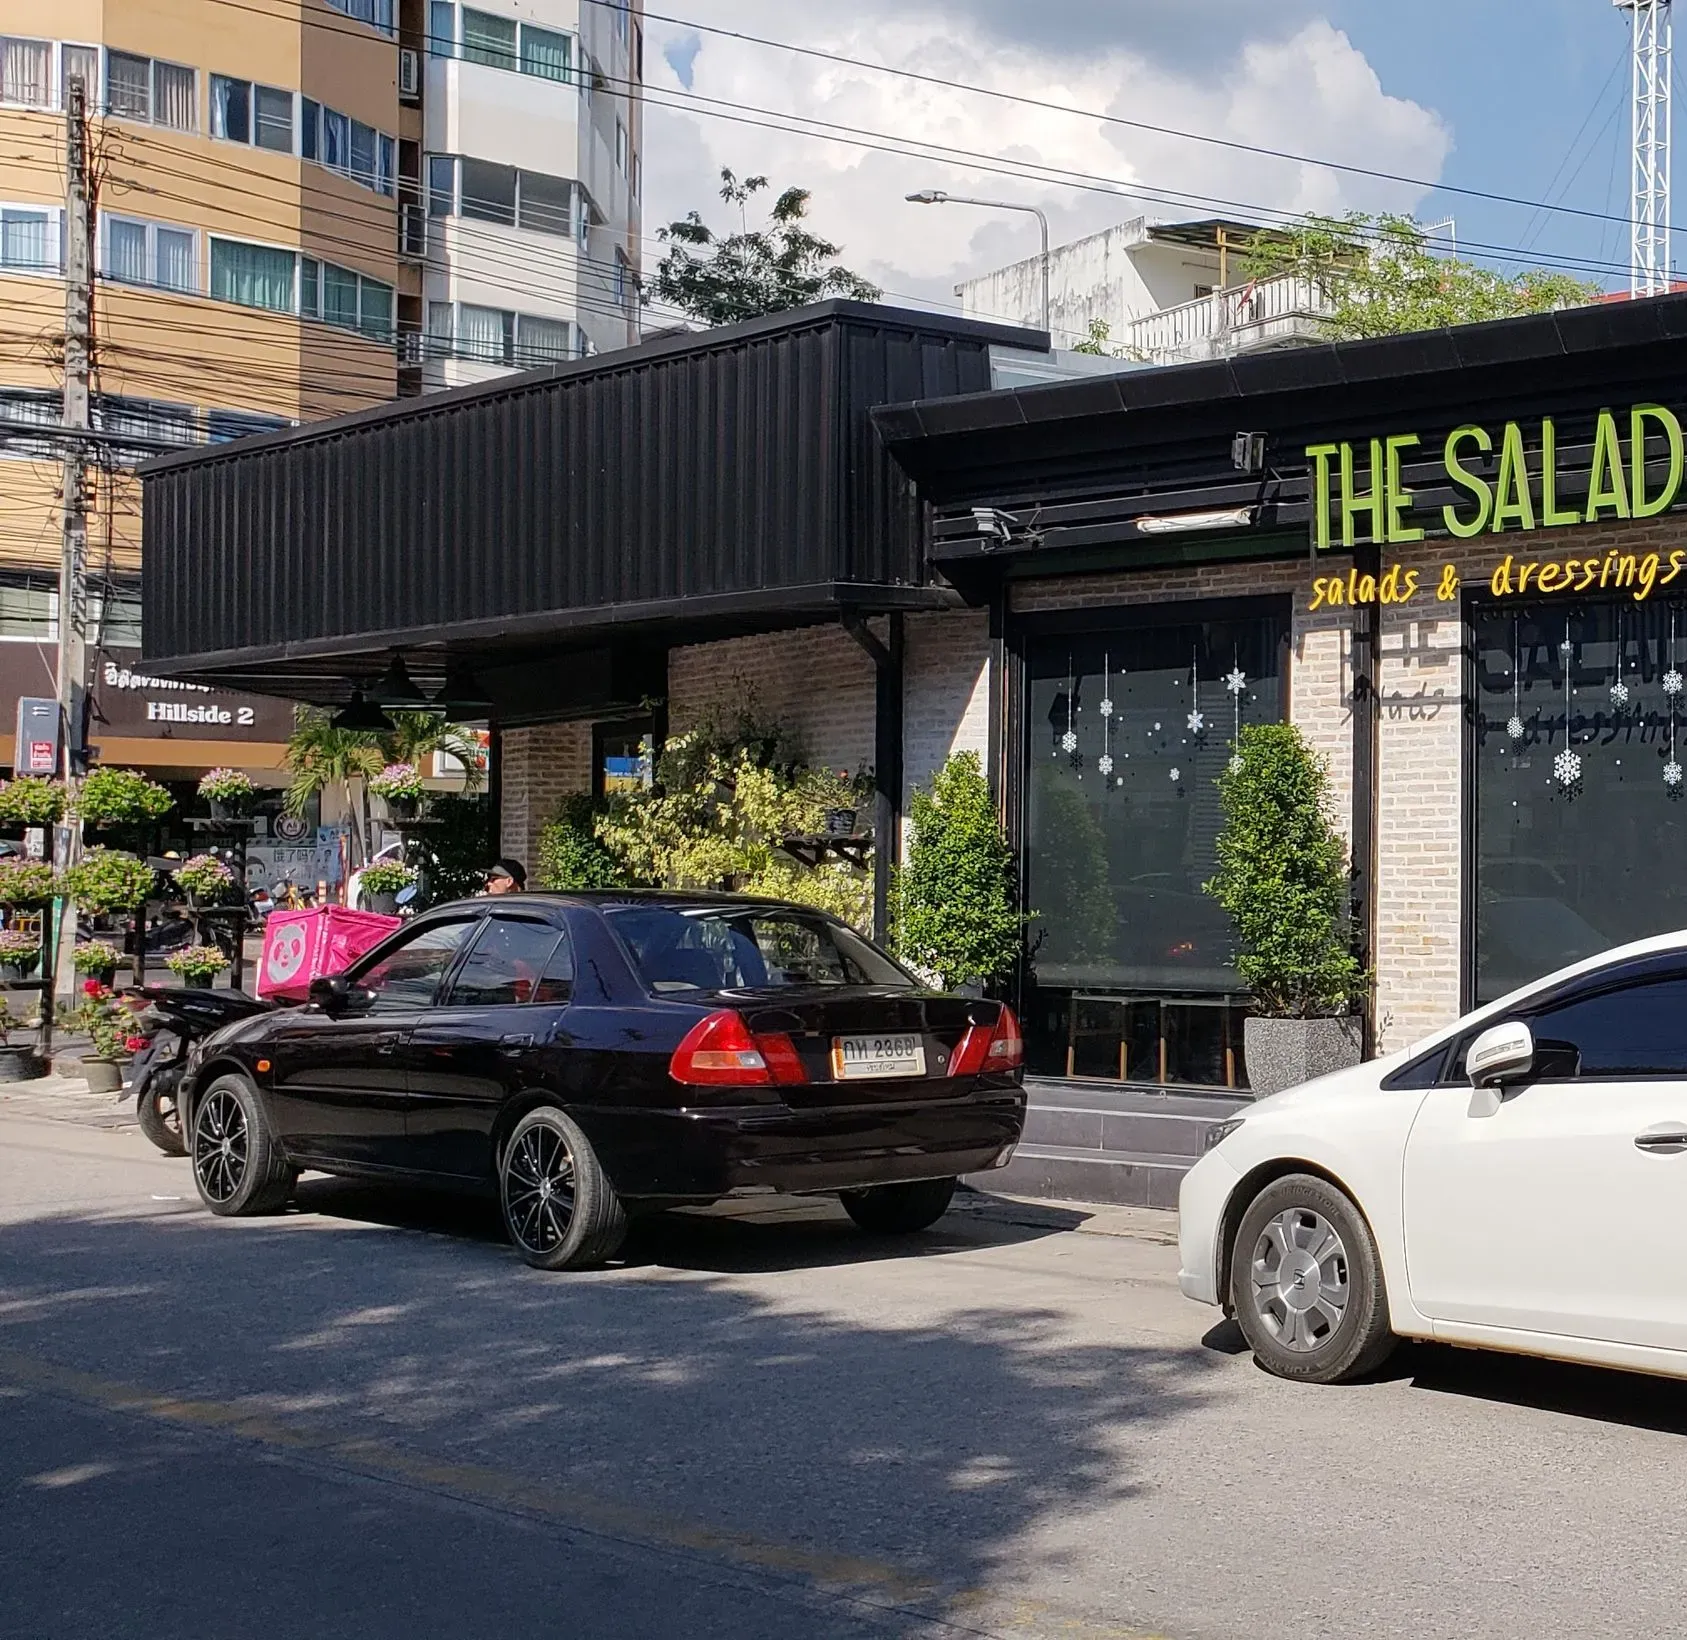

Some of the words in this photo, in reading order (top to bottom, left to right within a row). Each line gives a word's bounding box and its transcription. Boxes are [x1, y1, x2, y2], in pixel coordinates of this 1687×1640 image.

[1305, 433, 1425, 549] THE
[1442, 403, 1684, 538] SALAD
[1309, 565, 1419, 611] salads
[1438, 565, 1460, 601] &
[1492, 549, 1686, 600] dressings
[147, 702, 232, 724] Hillside
[237, 707, 254, 725] 2
